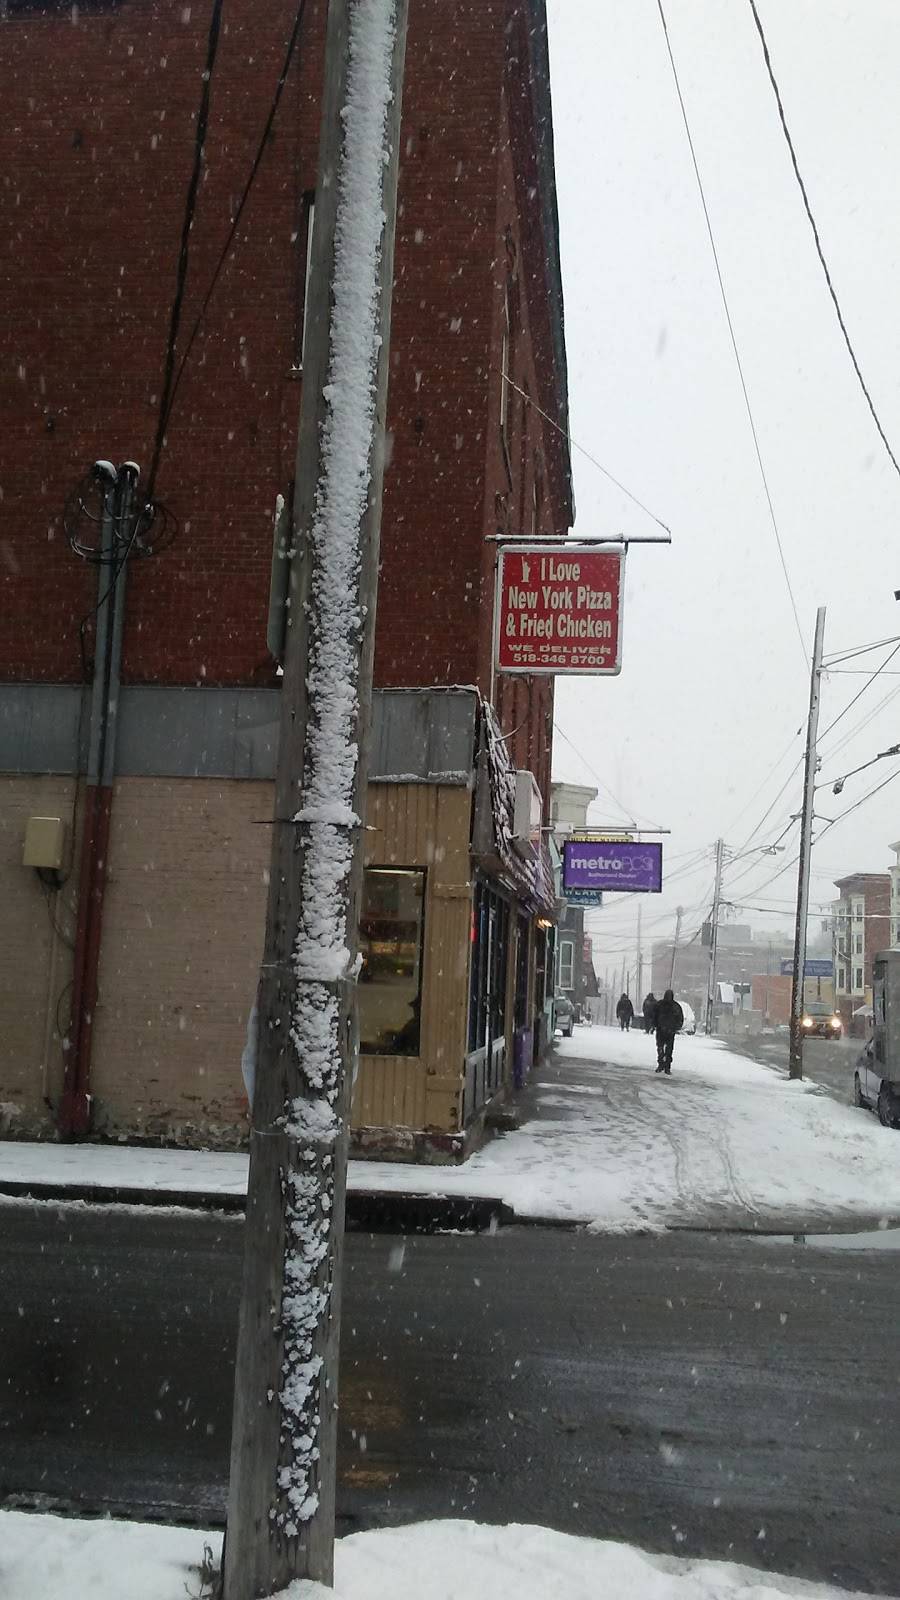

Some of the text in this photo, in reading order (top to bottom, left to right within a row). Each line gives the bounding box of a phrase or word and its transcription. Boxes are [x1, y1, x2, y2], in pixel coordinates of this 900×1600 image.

[541, 557, 581, 582] I Love
[508, 585, 612, 610] New York Pizza
[505, 613, 612, 638] & Fried Chicken
[508, 644, 611, 654] WE DELIVER
[513, 654, 605, 664] 518-346 8700
